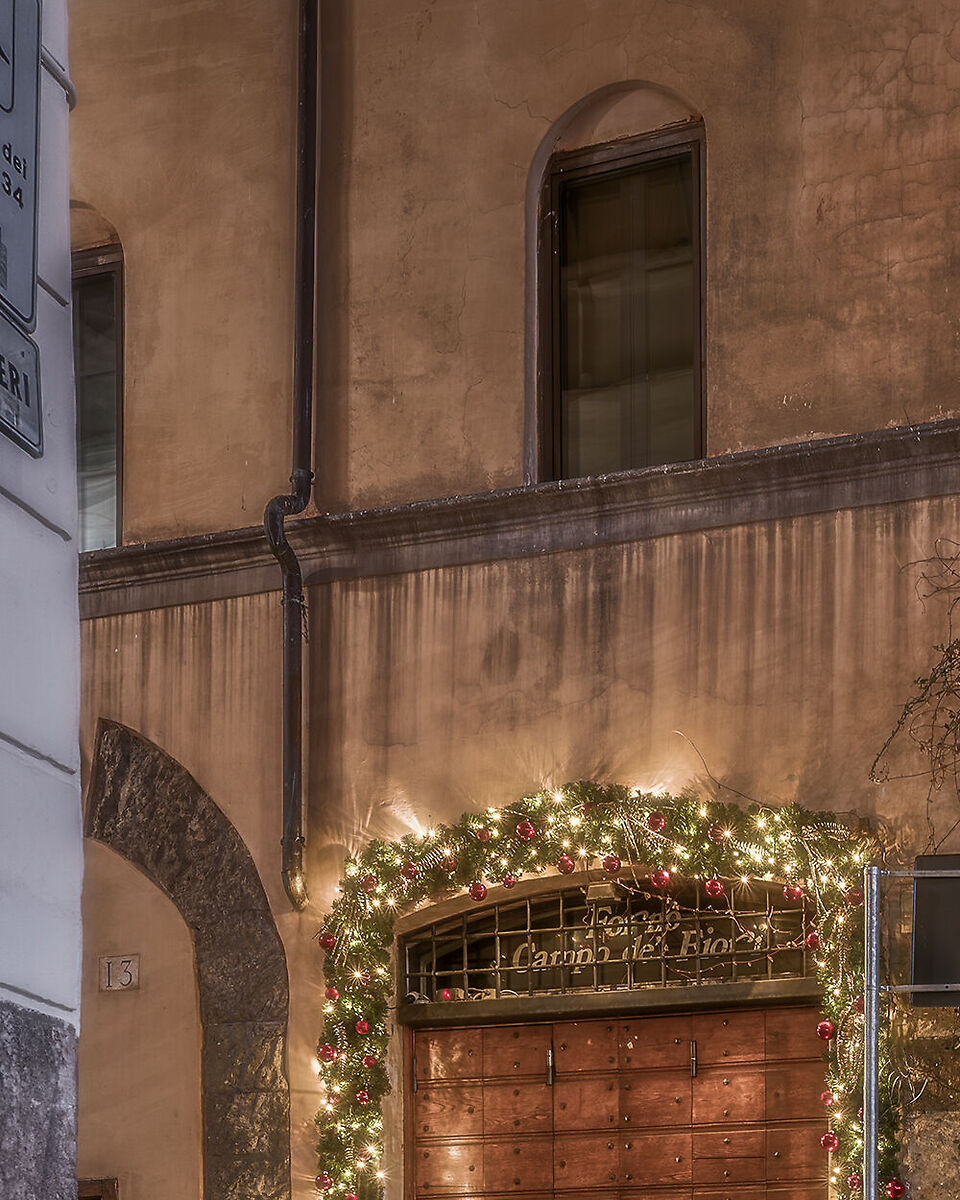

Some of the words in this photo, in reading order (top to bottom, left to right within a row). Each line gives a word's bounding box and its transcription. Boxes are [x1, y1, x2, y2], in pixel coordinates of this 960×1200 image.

[2, 142, 27, 180] dei
[2, 171, 24, 209] 34
[104, 959, 134, 989] 13
[512, 942, 611, 974] Campo
